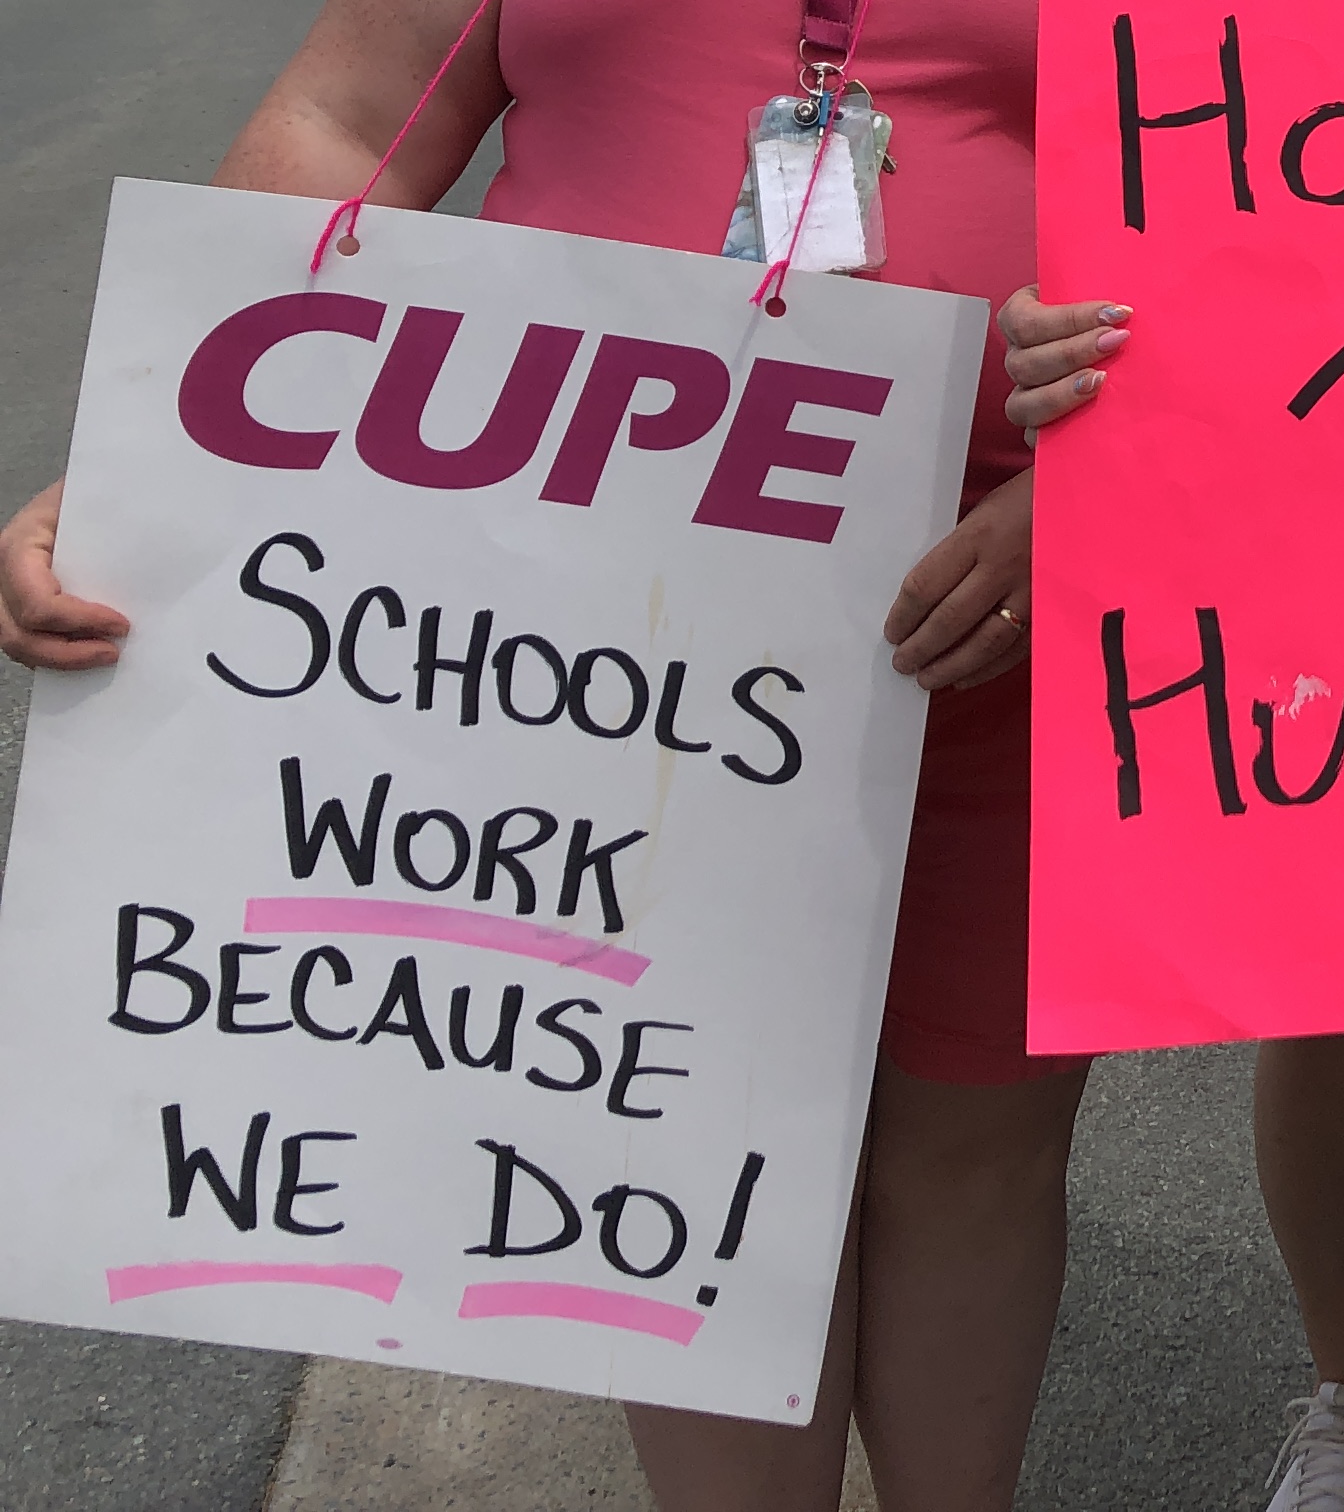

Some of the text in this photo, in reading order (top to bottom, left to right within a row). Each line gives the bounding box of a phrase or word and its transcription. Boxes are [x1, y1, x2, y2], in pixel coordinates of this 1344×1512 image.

[177, 291, 894, 545] CUPE
[205, 531, 806, 787] SCHOOLS
[279, 756, 650, 934] WORK
[107, 903, 695, 1119] BECAUSE
[160, 1103, 766, 1308] WE DO!
